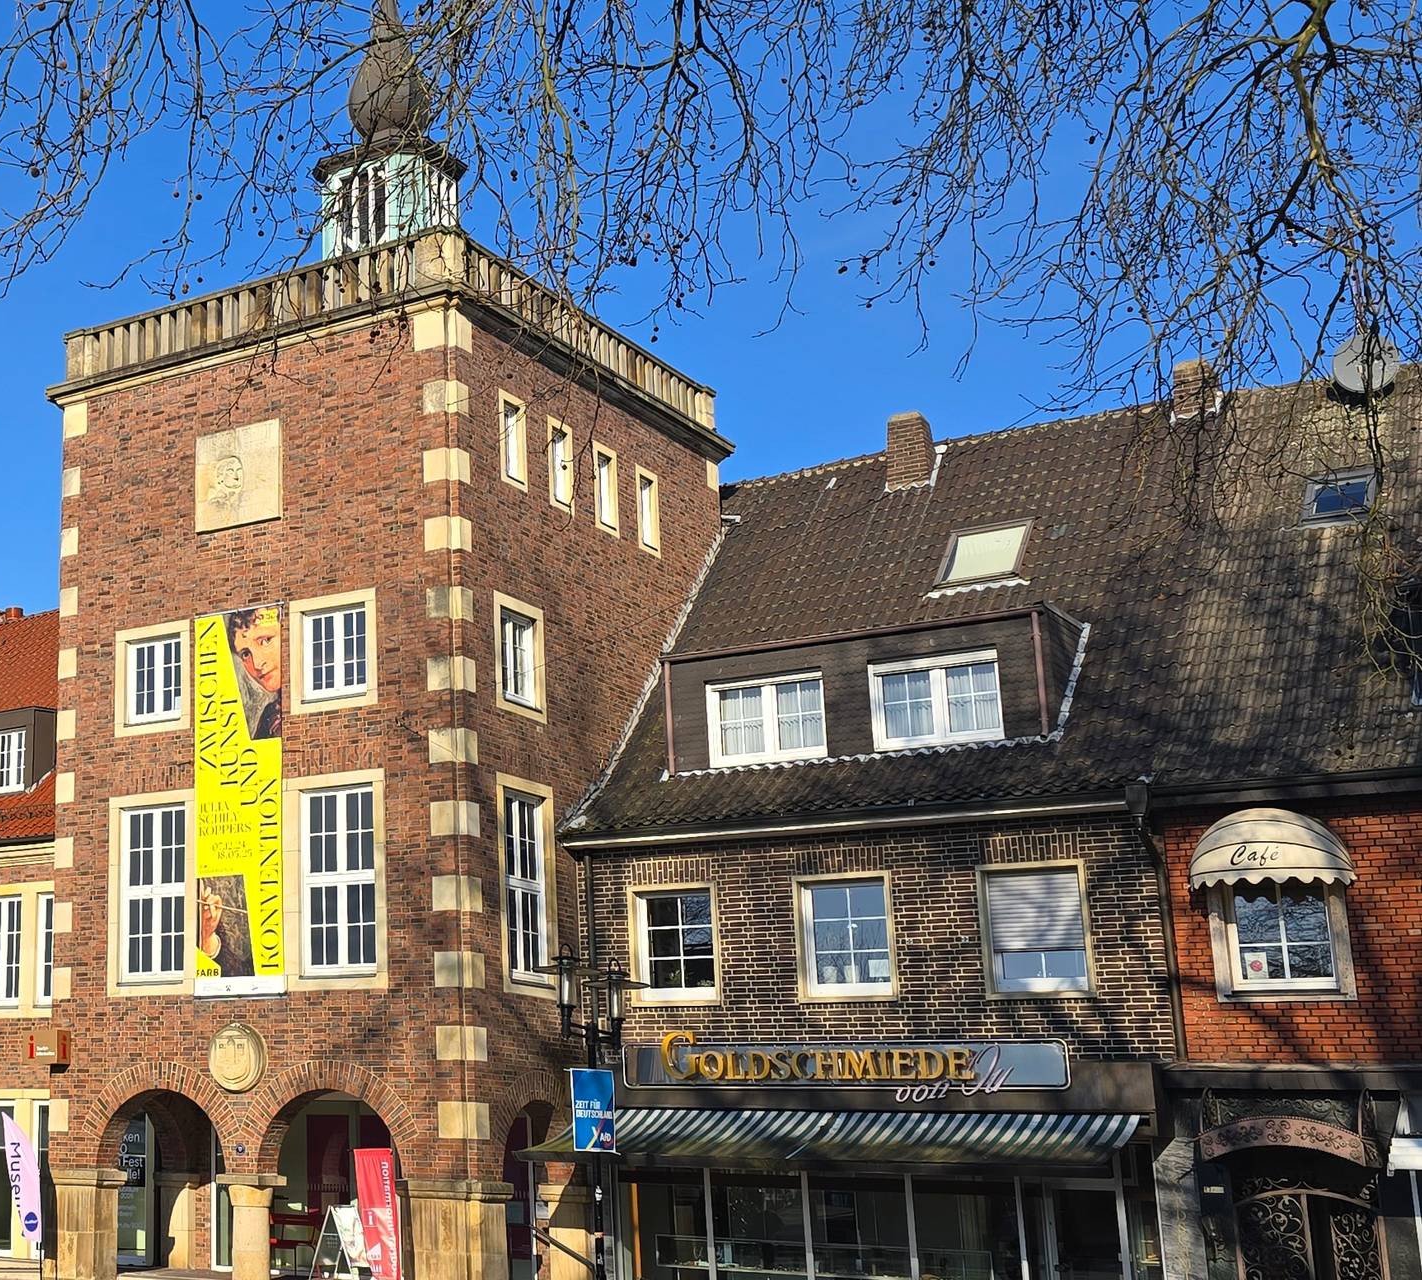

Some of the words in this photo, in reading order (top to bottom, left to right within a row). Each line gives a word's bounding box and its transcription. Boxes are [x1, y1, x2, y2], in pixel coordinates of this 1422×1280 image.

[199, 621, 218, 770] ZWISCHEN
[220, 695, 239, 787] KUNST
[240, 747, 258, 807] UND
[199, 801, 230, 814] JULIA
[199, 822, 252, 837] KOPPERS
[1230, 844, 1280, 867] Café
[258, 778, 279, 970] KONVENTION
[661, 1030, 976, 1082] GOLDSCHMIEDE
[575, 1100, 589, 1109] ZEIT
[590, 1098, 601, 1110] FÜR
[576, 1109, 613, 1119] DEUTSCHLAND
[600, 1132, 612, 1142] AfD
